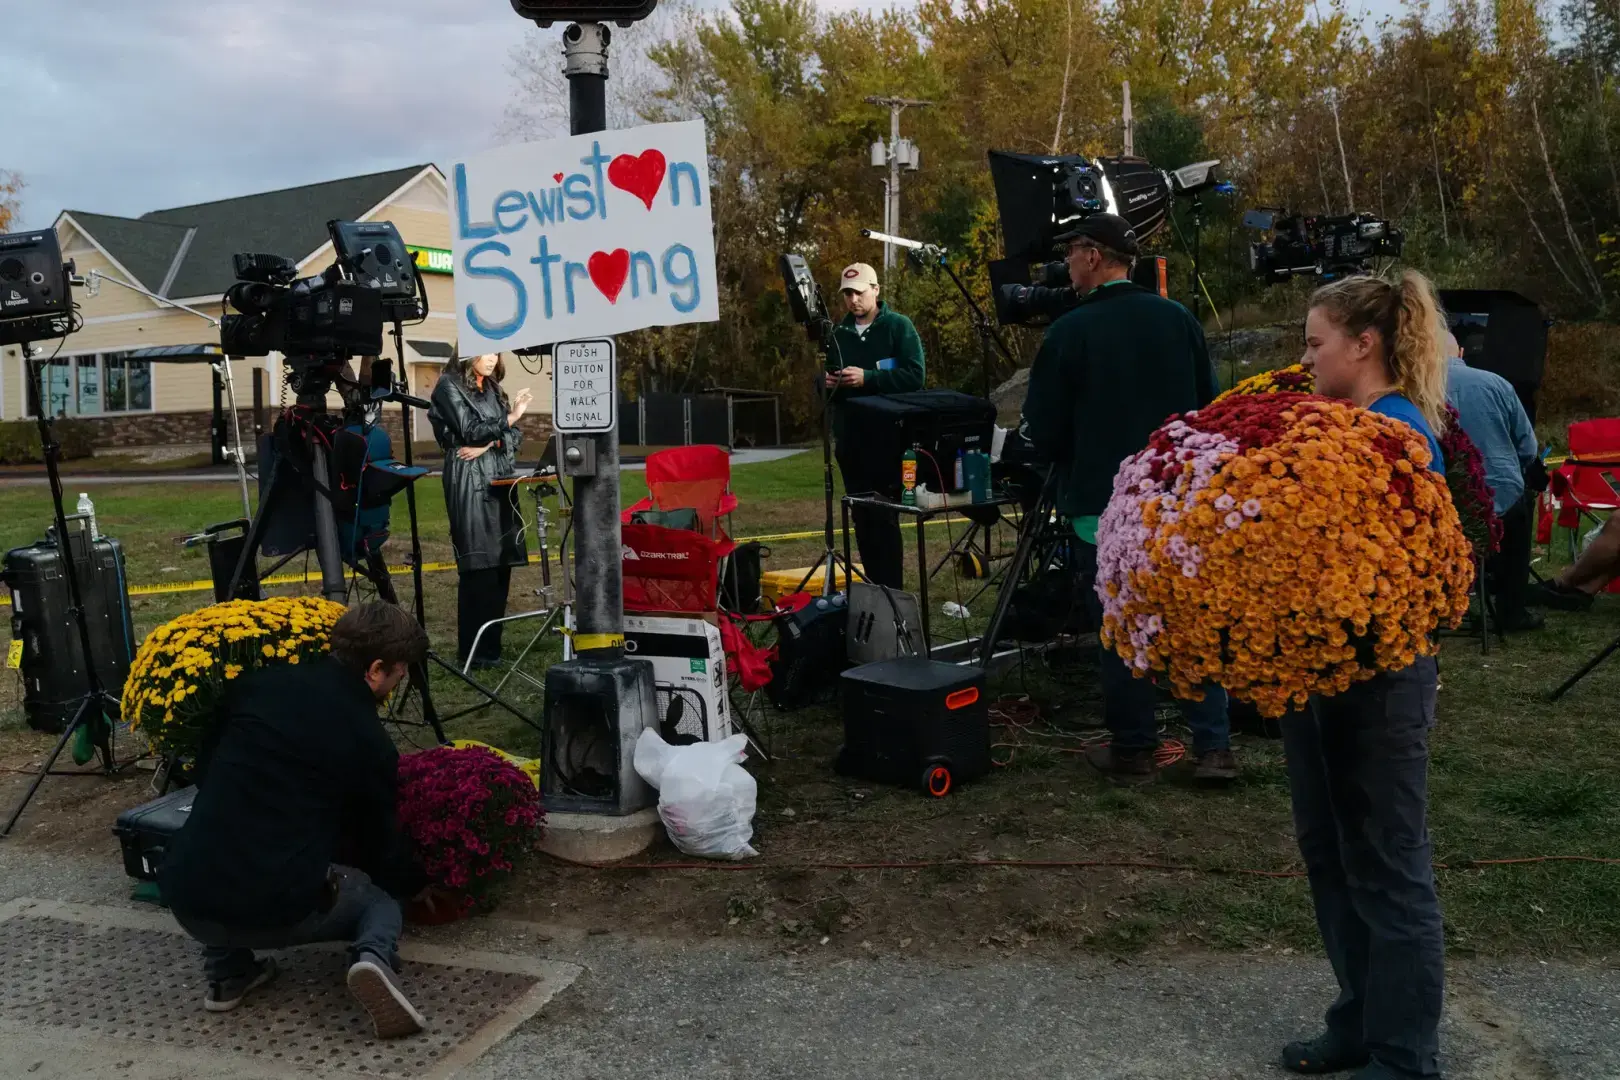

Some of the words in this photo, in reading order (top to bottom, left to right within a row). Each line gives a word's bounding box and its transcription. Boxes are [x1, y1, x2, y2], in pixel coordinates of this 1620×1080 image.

[569, 348, 597, 358] PUSH
[563, 363, 604, 374] BUTTON
[573, 380, 593, 390] FOR
[570, 397, 597, 406] WALK
[565, 412, 603, 422] SIGNAL
